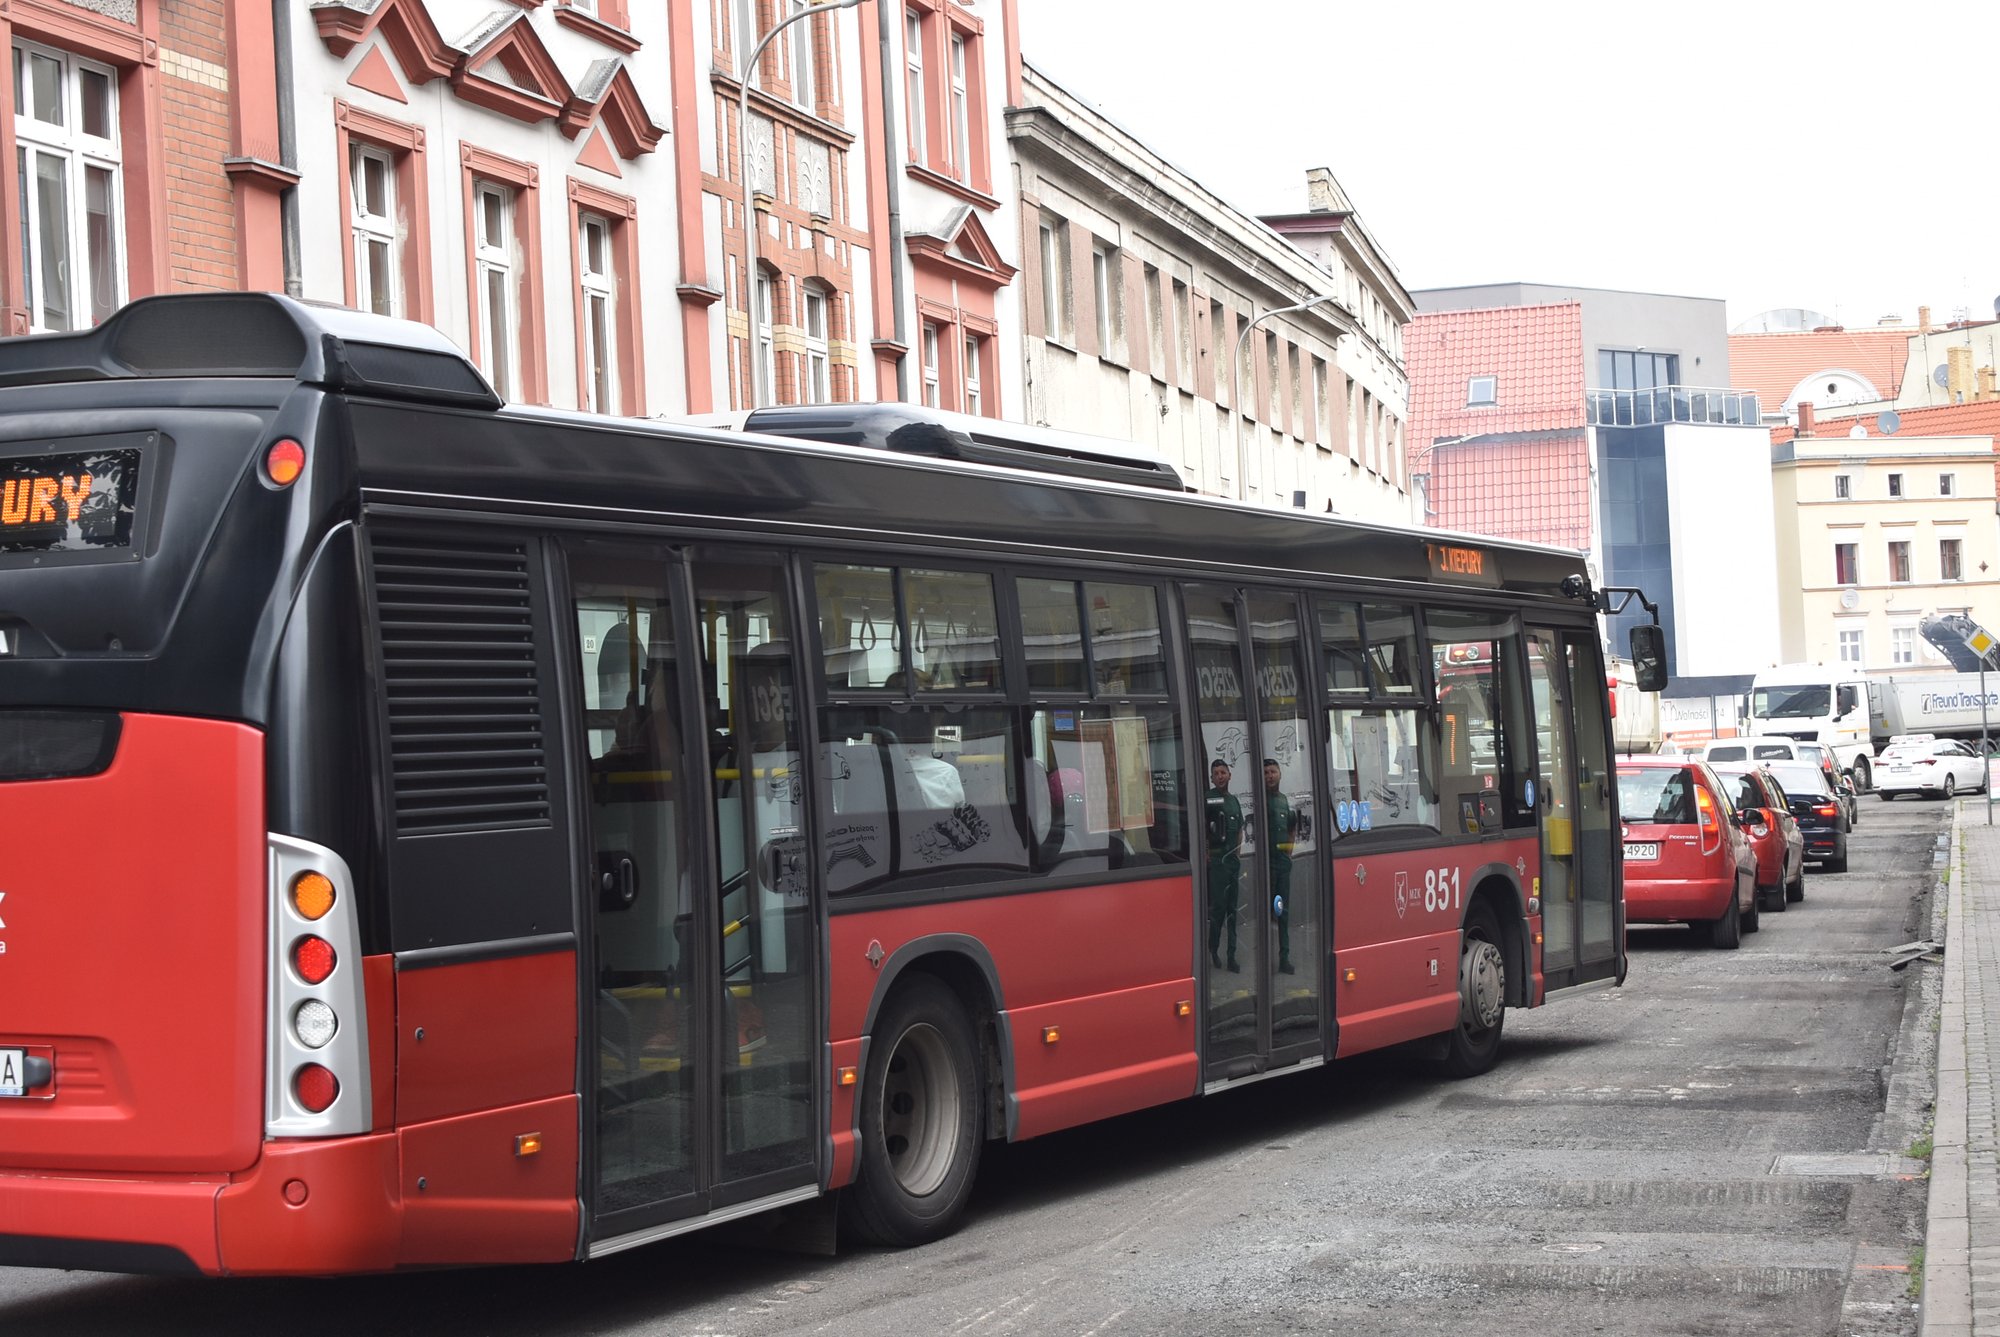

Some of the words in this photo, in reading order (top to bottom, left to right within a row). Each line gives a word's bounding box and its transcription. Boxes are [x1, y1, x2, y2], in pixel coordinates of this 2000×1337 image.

[1932, 692, 1958, 709] Freund
[1445, 713, 1456, 767] 7
[1424, 866, 1460, 913] 851
